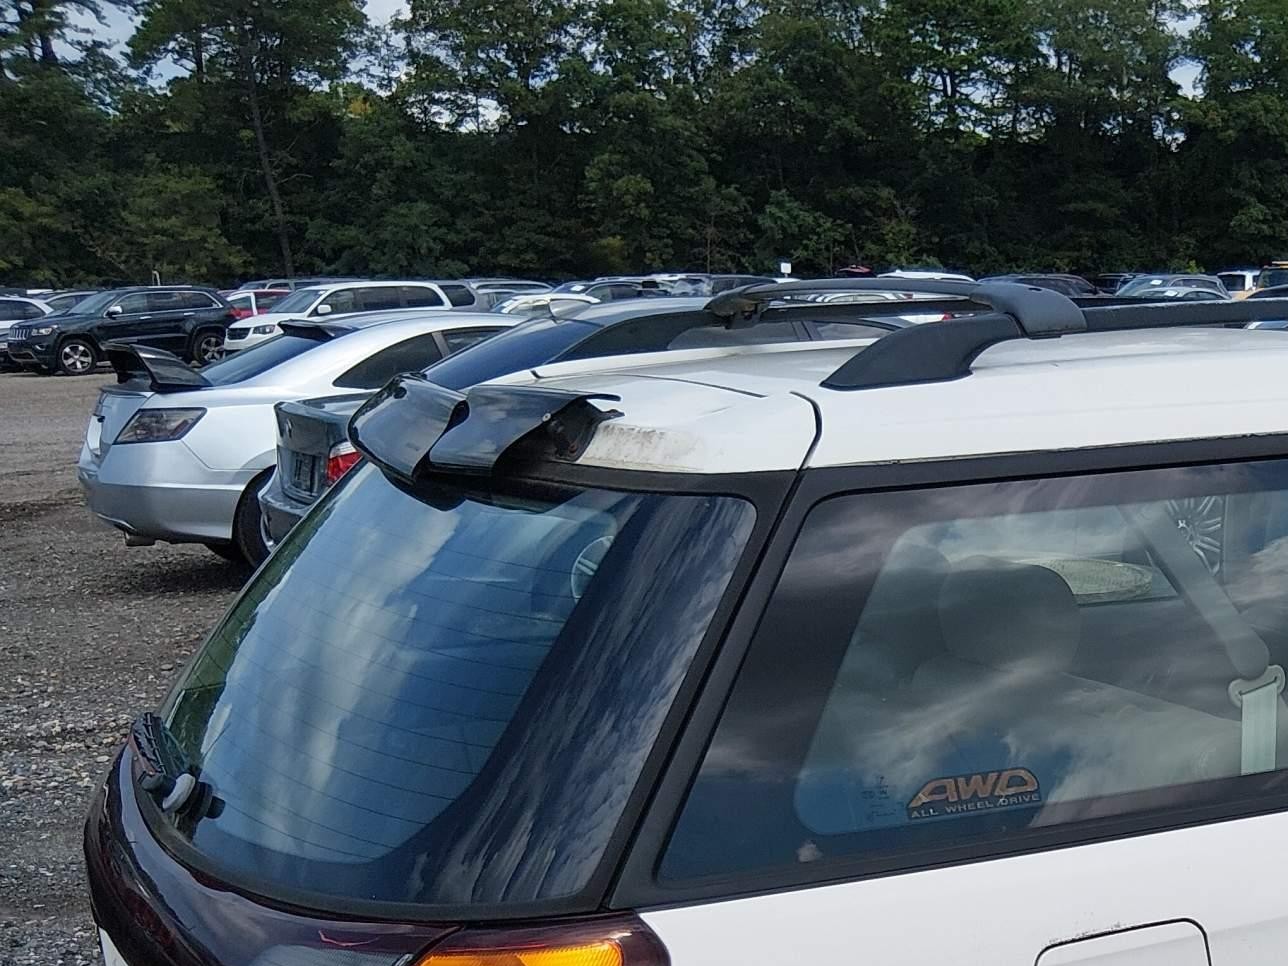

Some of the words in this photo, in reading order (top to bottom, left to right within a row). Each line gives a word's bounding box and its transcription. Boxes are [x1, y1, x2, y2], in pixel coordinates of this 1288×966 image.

[908, 768, 1039, 808] AWD
[911, 808, 938, 818] ALL
[945, 800, 994, 814] WHEEL
[997, 794, 1040, 807] DRIVE
